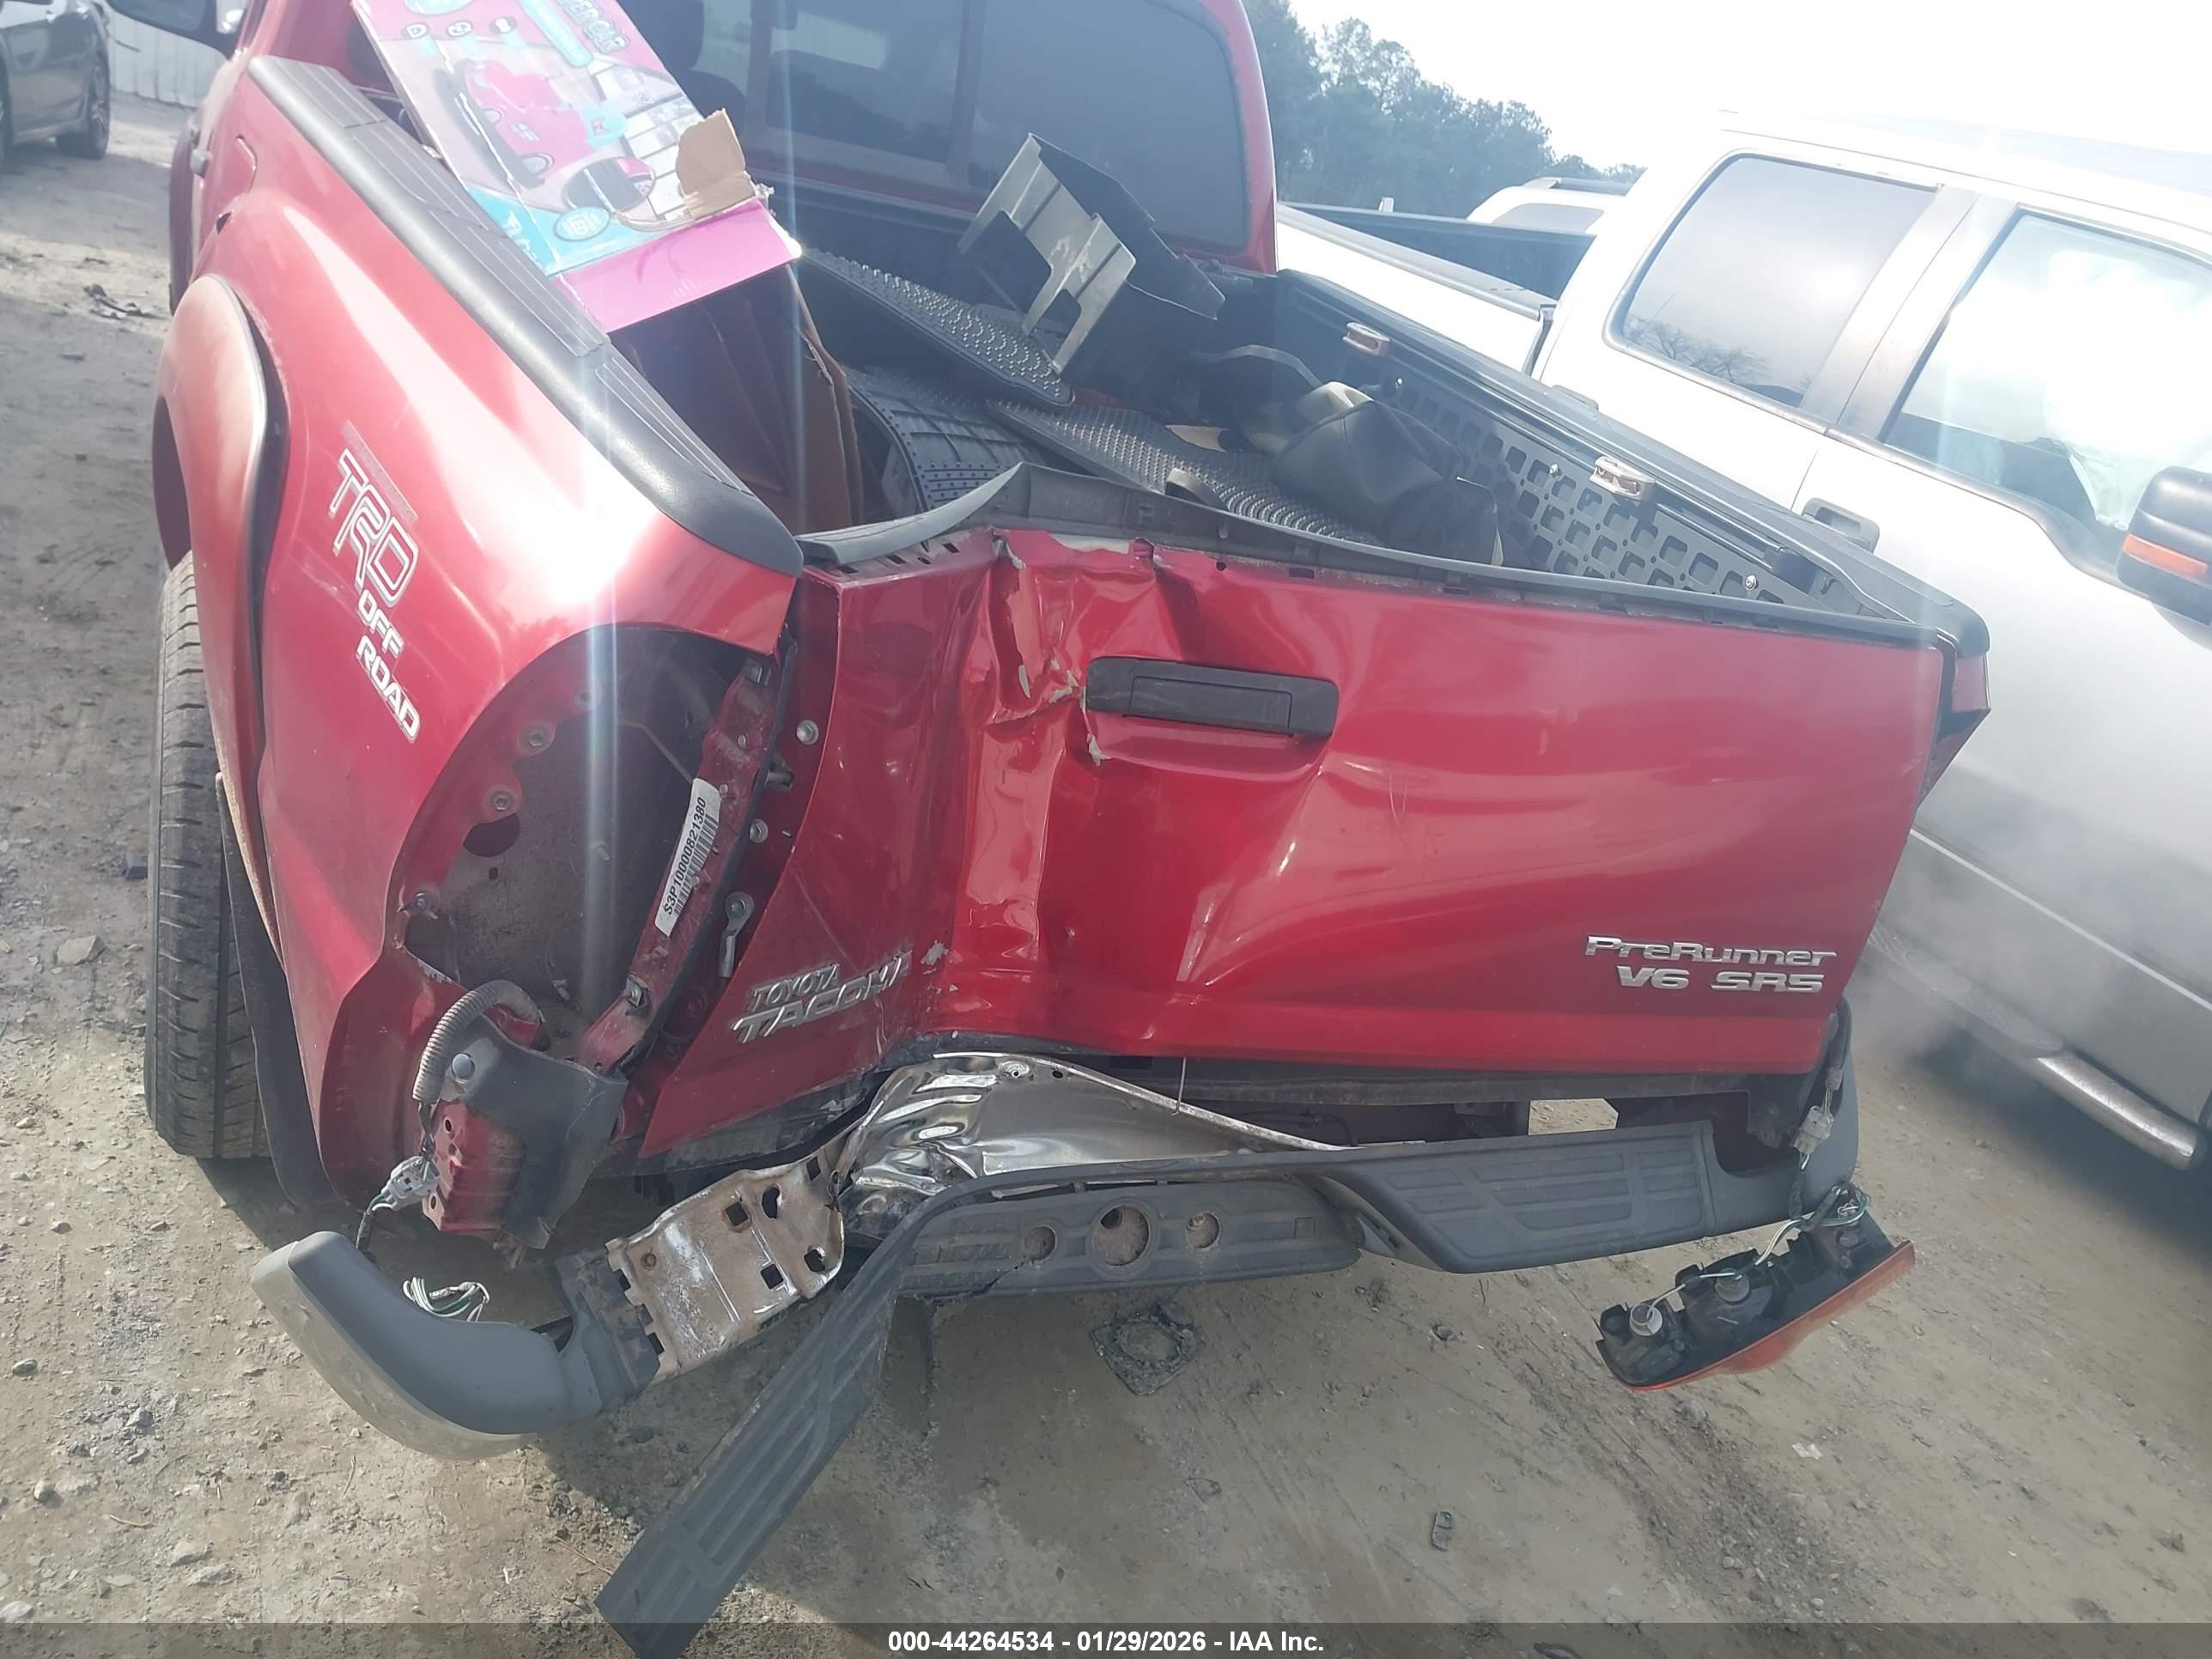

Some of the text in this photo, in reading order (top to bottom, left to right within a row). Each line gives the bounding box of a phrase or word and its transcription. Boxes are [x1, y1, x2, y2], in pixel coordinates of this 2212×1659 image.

[329, 448, 419, 607] TRD
[356, 589, 404, 659] OFF
[356, 635, 421, 744] ROAD
[663, 796, 707, 916] S3P10000821380
[1584, 935, 1838, 967] PreRunner
[1616, 965, 1825, 993] V6 SR5
[746, 963, 840, 1012] TOYOTA
